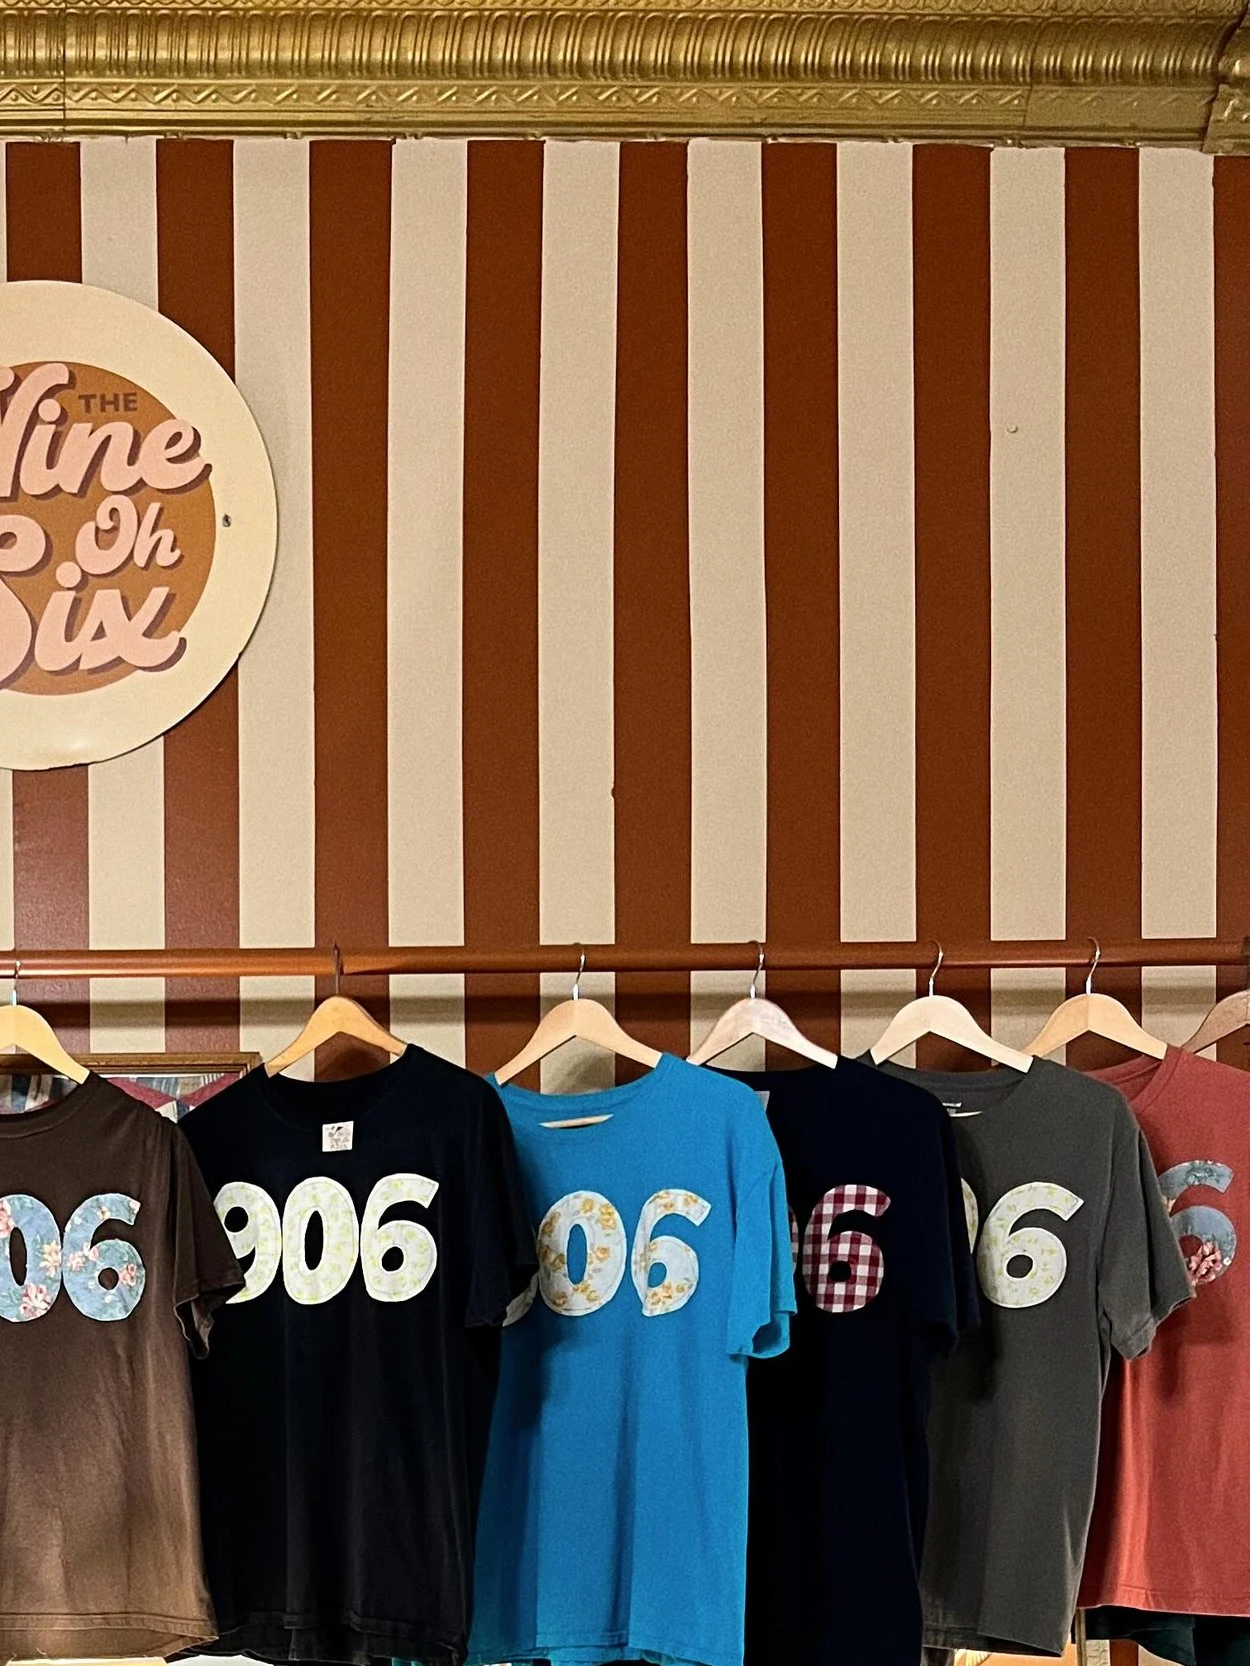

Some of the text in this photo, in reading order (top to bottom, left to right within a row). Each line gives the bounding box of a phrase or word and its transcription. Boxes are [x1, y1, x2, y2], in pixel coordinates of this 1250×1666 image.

[78, 392, 138, 413] THE
[75, 494, 183, 576] Oh
[214, 1173, 439, 1305] 906
[503, 1188, 712, 1326] 06
[789, 1184, 891, 1313] 6
[960, 1177, 1085, 1309] 6
